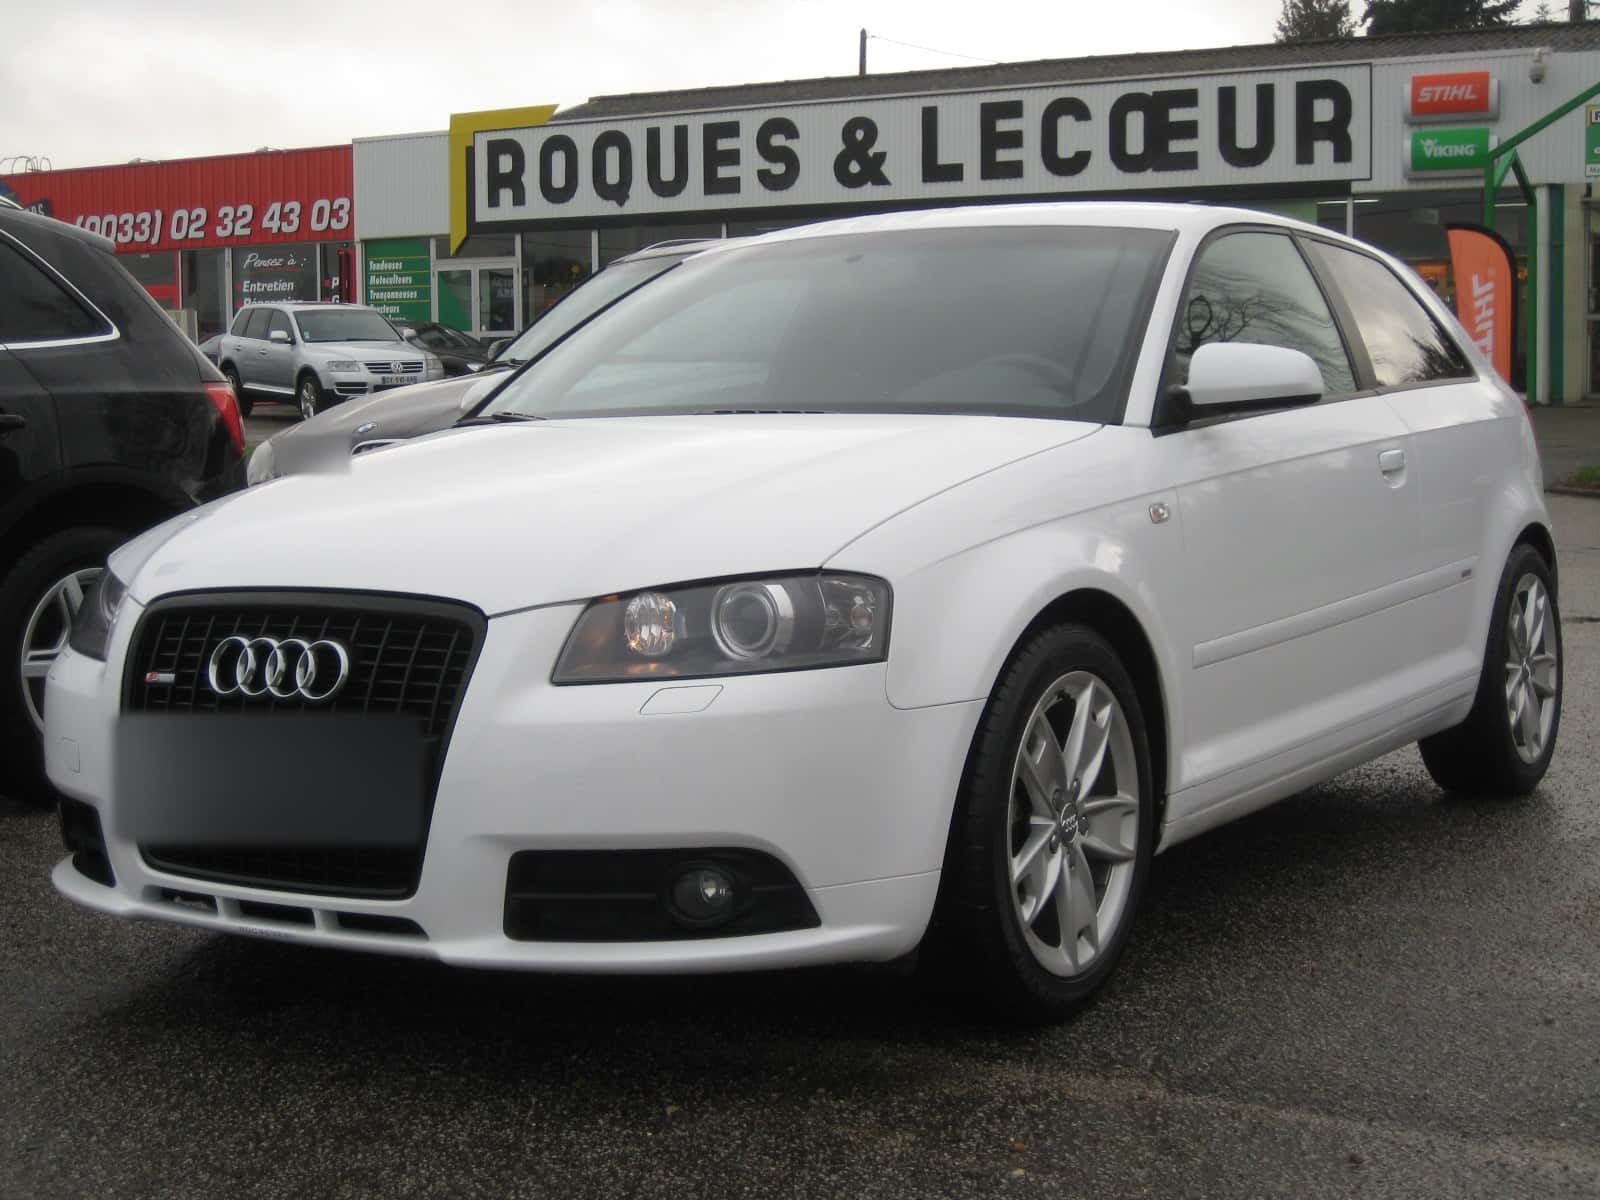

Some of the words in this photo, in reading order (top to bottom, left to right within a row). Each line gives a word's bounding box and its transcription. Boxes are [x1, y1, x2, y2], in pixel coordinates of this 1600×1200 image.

[1417, 84, 1479, 103] STIHL
[486, 116, 801, 208] ROQUES
[833, 116, 892, 190] &
[921, 78, 1353, 184] LECŒUR
[1421, 139, 1475, 158] VIKING
[171, 207, 207, 240] 02
[216, 204, 254, 237] 32
[262, 201, 301, 234] 43
[310, 197, 351, 231] 03
[243, 253, 284, 269] Pensez
[369, 260, 403, 272] Tondeuses
[242, 279, 295, 292] Entretien
[369, 274, 413, 285] Motoculteurs
[370, 290, 417, 302] Tronçonneuses
